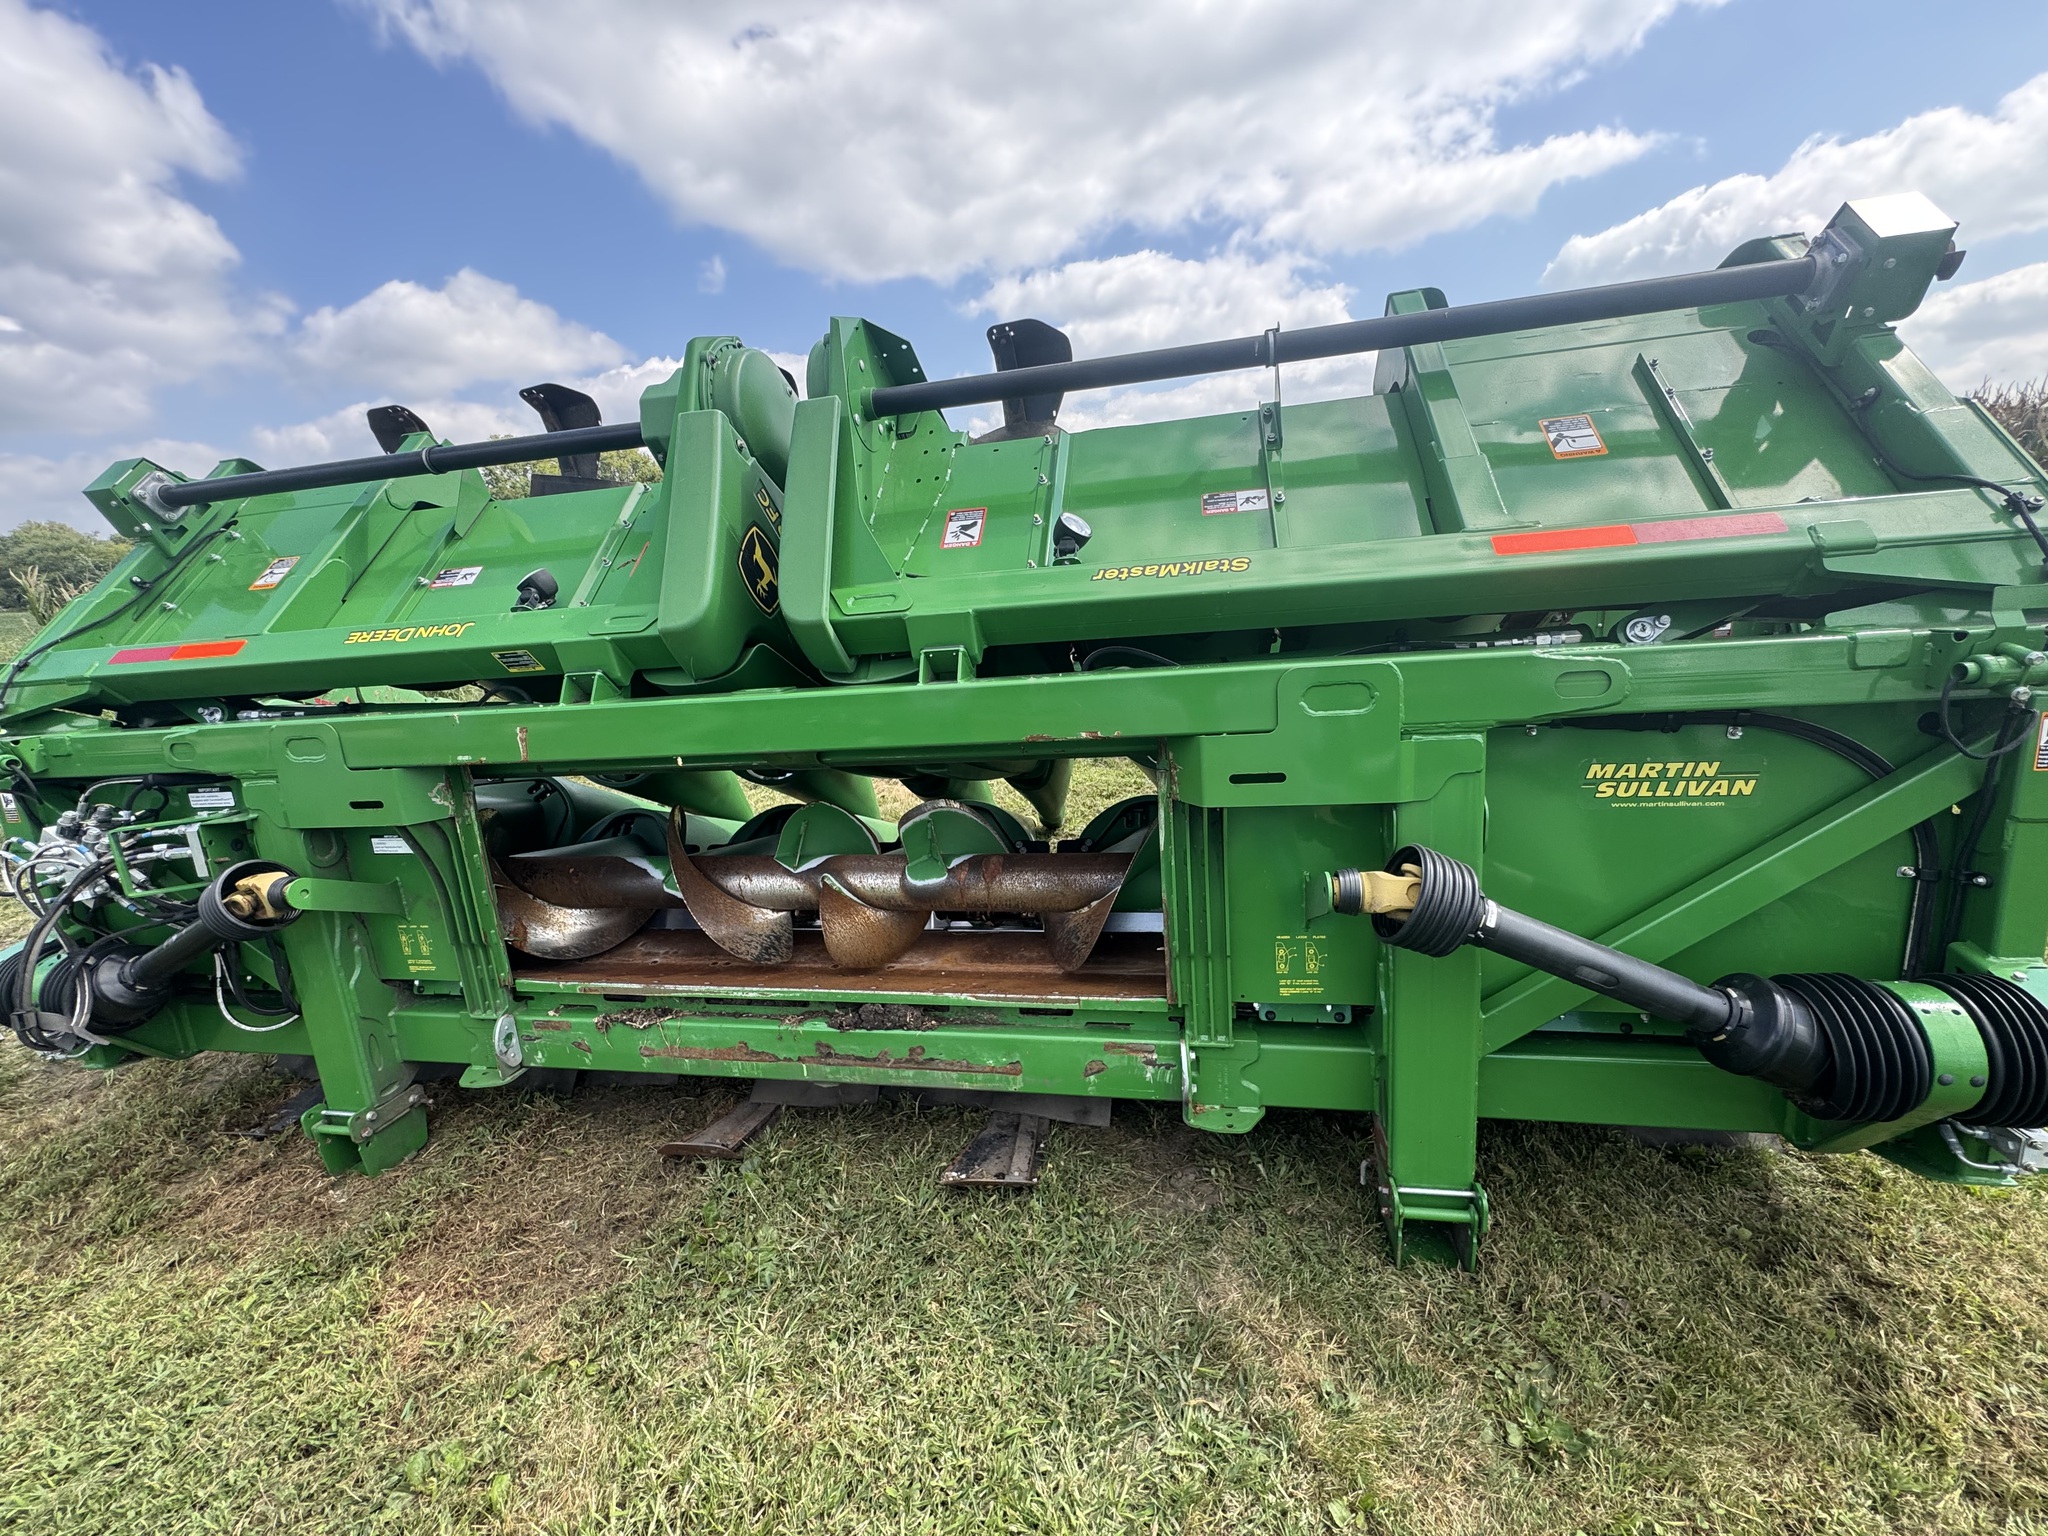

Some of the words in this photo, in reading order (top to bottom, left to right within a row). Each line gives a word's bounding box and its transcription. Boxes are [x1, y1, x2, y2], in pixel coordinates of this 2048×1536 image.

[1560, 449, 1595, 458] WARNING
[1090, 556, 1252, 582] StalkMaster
[343, 627, 416, 644] DEERE
[413, 621, 475, 639] JOHN
[1585, 761, 1721, 780] MARTIN
[1594, 779, 1758, 798] SULLIVAN
[1611, 800, 1725, 808] www.martinsullivan.com
